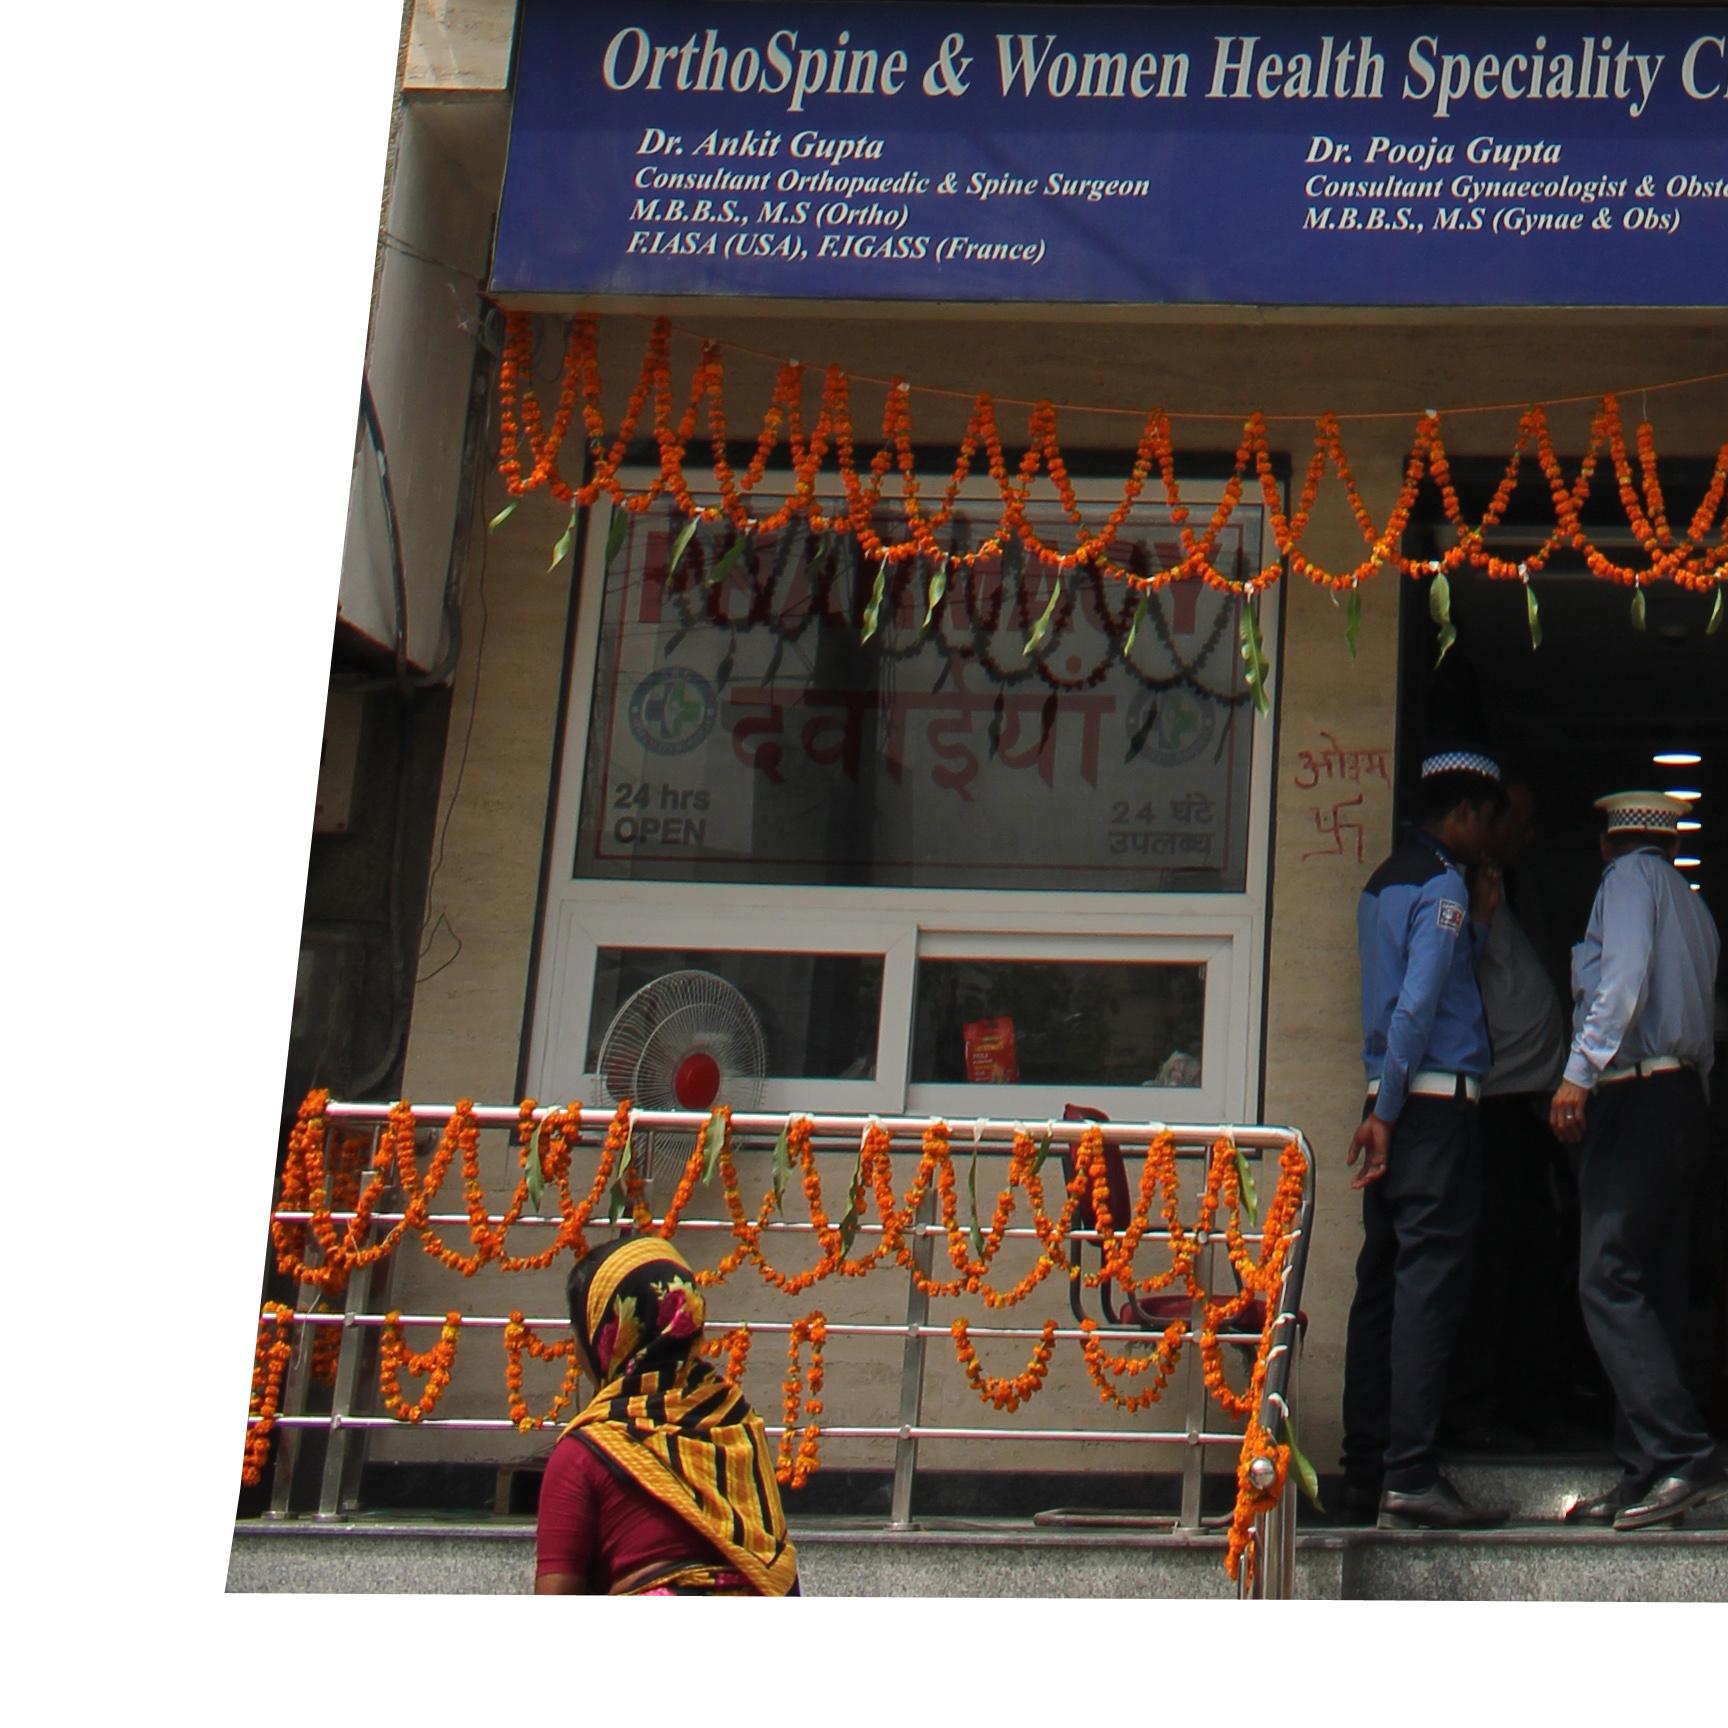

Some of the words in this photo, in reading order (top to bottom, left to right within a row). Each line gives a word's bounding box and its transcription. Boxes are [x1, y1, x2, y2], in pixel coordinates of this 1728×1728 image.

[601, 25, 907, 114] OrthoSpine
[922, 31, 973, 98] &
[995, 32, 1190, 99] Women
[1204, 34, 1386, 100] Health
[1401, 34, 1666, 118] Speciality
[636, 127, 684, 157] Dr.
[691, 128, 782, 159] Ankit
[789, 129, 886, 167] Gupta
[1304, 135, 1352, 165] Dr.
[1364, 135, 1455, 172] Pooja
[1466, 135, 1563, 172] Gupta
[633, 165, 772, 191] Consultant
[776, 168, 931, 198] Orthopaedic
[936, 171, 959, 194] &
[965, 171, 1038, 201] Spine
[1042, 172, 1151, 202] Surgeon
[1304, 174, 1444, 199] Consultant
[1450, 174, 1628, 204] Gynaecologist
[1634, 174, 1656, 198] &
[756, 200, 812, 225] M.S
[815, 201, 909, 231] (Ortho)
[1432, 207, 1486, 231] M.S
[1492, 207, 1584, 236] (Gynae
[1591, 206, 1613, 231] &
[1622, 206, 1681, 234] Obs)
[723, 231, 809, 263] (USA),
[935, 236, 1047, 265] (France)
[613, 782, 651, 810] 24
[660, 783, 712, 811] hrs
[614, 815, 707, 846] OPEN
